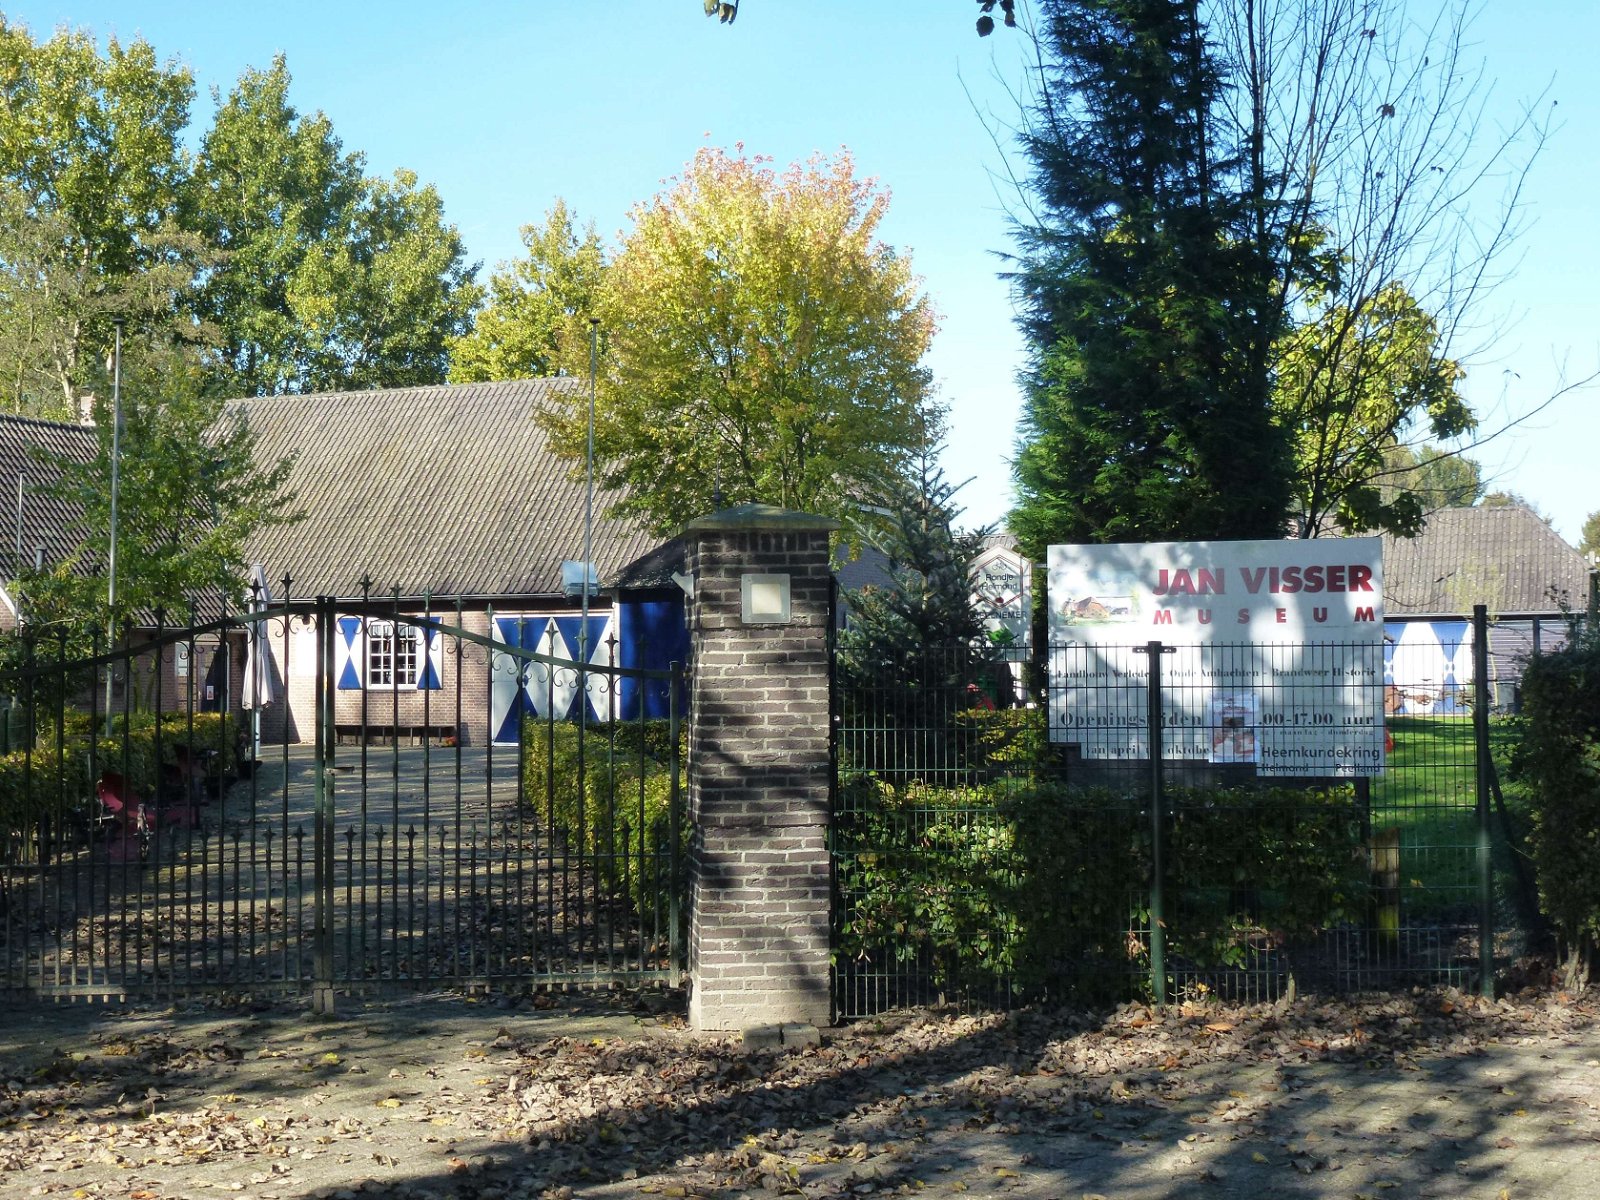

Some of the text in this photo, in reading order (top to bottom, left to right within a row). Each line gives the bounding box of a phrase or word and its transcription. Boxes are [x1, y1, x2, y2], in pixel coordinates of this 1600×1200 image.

[985, 573, 1014, 583] Rondje
[1152, 565, 1374, 596] JAN VISSER
[1153, 606, 1375, 625] MUSEUM
[1112, 669, 1151, 678] Verlede
[1271, 668, 1330, 677] Brandweer
[1333, 667, 1376, 677] Hstorie
[1060, 712, 1202, 728] Openingsjden
[1342, 716, 1375, 725] uur
[1167, 744, 1210, 755] oktobe
[1261, 745, 1380, 761] Heemkundekring
